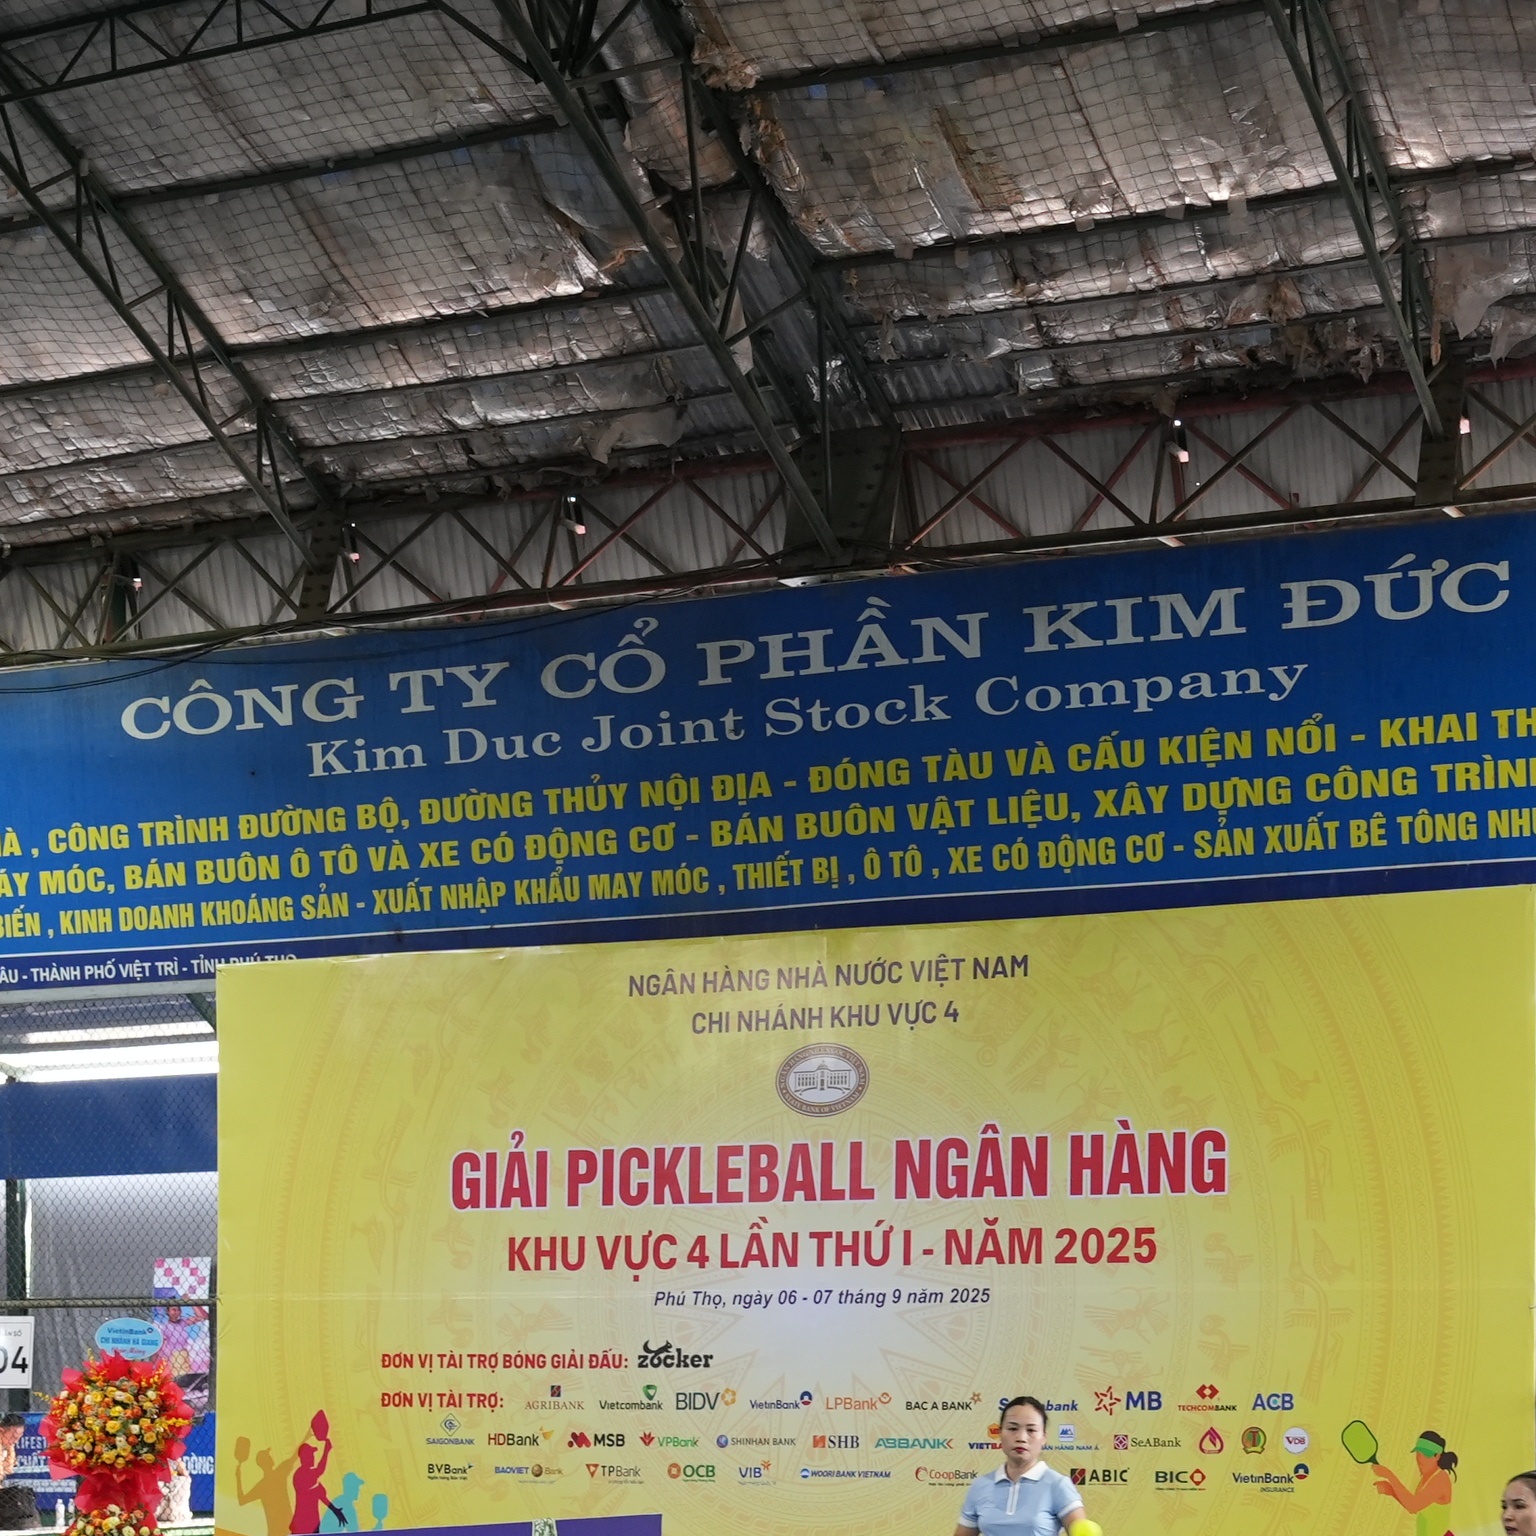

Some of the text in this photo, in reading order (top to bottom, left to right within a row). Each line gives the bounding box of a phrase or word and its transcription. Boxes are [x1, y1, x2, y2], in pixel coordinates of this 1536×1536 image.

[121, 554, 1509, 739] CÔNG TY CỔ PHẦN KIM ĐỨC
[307, 664, 1308, 776] Kim Duc Joint Stock Company
[48, 822, 129, 853] CÔNG
[138, 815, 229, 847] TRÌNH
[238, 804, 346, 839] ĐƯỜNG
[357, 797, 409, 833] BỘ,
[419, 788, 533, 824] ĐƯỜNG
[543, 774, 627, 814] THỦY
[640, 773, 699, 810] NỘI
[711, 772, 772, 805] ĐỊA
[808, 758, 909, 793] ĐÓNG
[922, 748, 992, 782] TÀU
[1005, 741, 1055, 776] VÀ
[1068, 731, 1145, 771] CẤU
[1159, 727, 1252, 768] KIỆN
[1266, 713, 1336, 756] NỔI
[1380, 712, 1477, 747] KHAI
[31, 964, 81, 983] THÀNH
[85, 957, 116, 979] PHỐ
[119, 962, 152, 982] VIỆT
[155, 957, 178, 976] TRÌ
[629, 953, 1029, 997] NGÂN HÀNG NHÀ NƯỚC VIỆT NAM
[691, 1000, 959, 1034] CHI NHÁNH KHU VỰC 4
[452, 1119, 1226, 1210] GIẢI PICKLEBALL NGÂN HÀNG
[508, 1217, 1156, 1281] KHU VỰC 4 LẦN THỨ I NĂM 2025
[654, 1288, 990, 1310] Phú Thọ, ngày 06 07 tháng 9 năm 2025
[381, 1353, 413, 1369] ĐƠN
[418, 1354, 433, 1373] VỊ
[437, 1350, 462, 1369] TÀI
[467, 1353, 498, 1372] TRỢ
[503, 1349, 546, 1369] BÓNG
[551, 1349, 583, 1369] GIẢI
[588, 1349, 628, 1369] ĐẤU:
[381, 1389, 1293, 1412] ĐƠN VỊ TÀI TRỢ: AGRIBANK Vietcombank BIDV VietinBank LPBank BAC A BANK MB TECHCOMBANK ACB
[488, 1433, 539, 1447] HDBank
[594, 1434, 625, 1447] MSB
[657, 1437, 699, 1447] VPBank
[731, 1438, 769, 1446] SHINHAN
[772, 1438, 796, 1446] BANK
[828, 1436, 860, 1448] SHB
[1131, 1437, 1181, 1448] SeABank
[427, 1463, 1294, 1484] BVBank TPBank OCB VIB WOORI BANK VIETNAM ABIC BIC VietinBank
